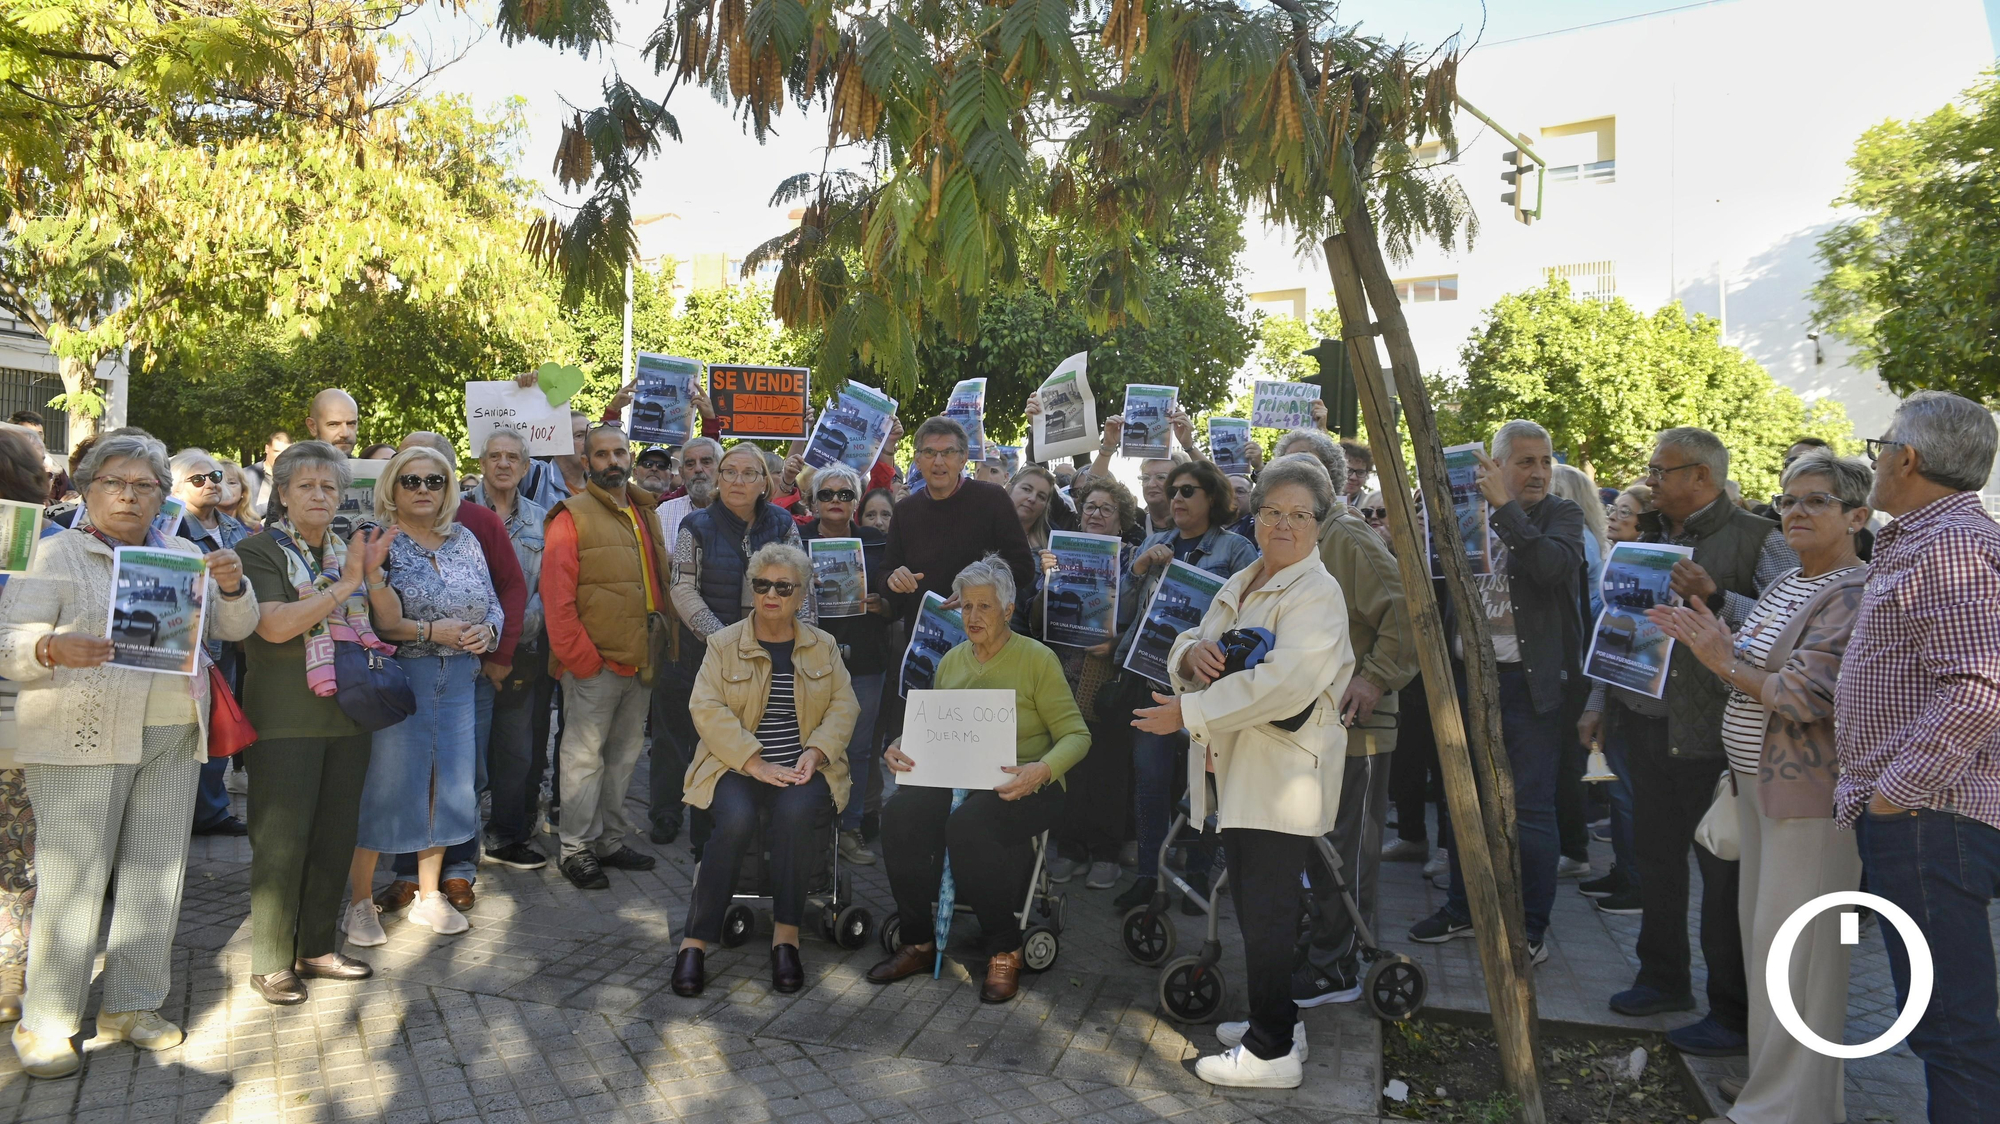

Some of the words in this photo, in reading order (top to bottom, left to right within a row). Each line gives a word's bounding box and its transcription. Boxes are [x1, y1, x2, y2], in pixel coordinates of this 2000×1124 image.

[714, 371, 737, 390] SE
[743, 372, 804, 393] VENDE
[664, 400, 680, 409] SALUD
[736, 395, 800, 412] SANIDAD
[473, 407, 516, 418] SANIDAD
[670, 407, 680, 415] NO
[736, 415, 801, 431] PUBLICA
[530, 425, 555, 442] 100%
[1462, 516, 1474, 529] NO
[845, 580, 855, 588] NO
[1082, 588, 1099, 600] SALUD
[1088, 598, 1100, 608] NO
[159, 606, 181, 619] SALUD
[1084, 603, 1113, 620] RESPONDE
[167, 617, 183, 628] NO
[1069, 623, 1094, 632] FUENSANTA
[1638, 618, 1650, 626] SAL
[161, 623, 196, 641] RESPONDE
[1642, 626, 1657, 638] NO
[138, 645, 171, 654] FUENSANTA
[1138, 650, 1148, 658] POR
[1616, 656, 1644, 668] FUENSANTA
[1643, 664, 1660, 673] DIGNA
[914, 700, 927, 723] A
[938, 706, 963, 722] LAS
[973, 706, 1015, 723] 00:01
[926, 729, 980, 743] DUERMO
